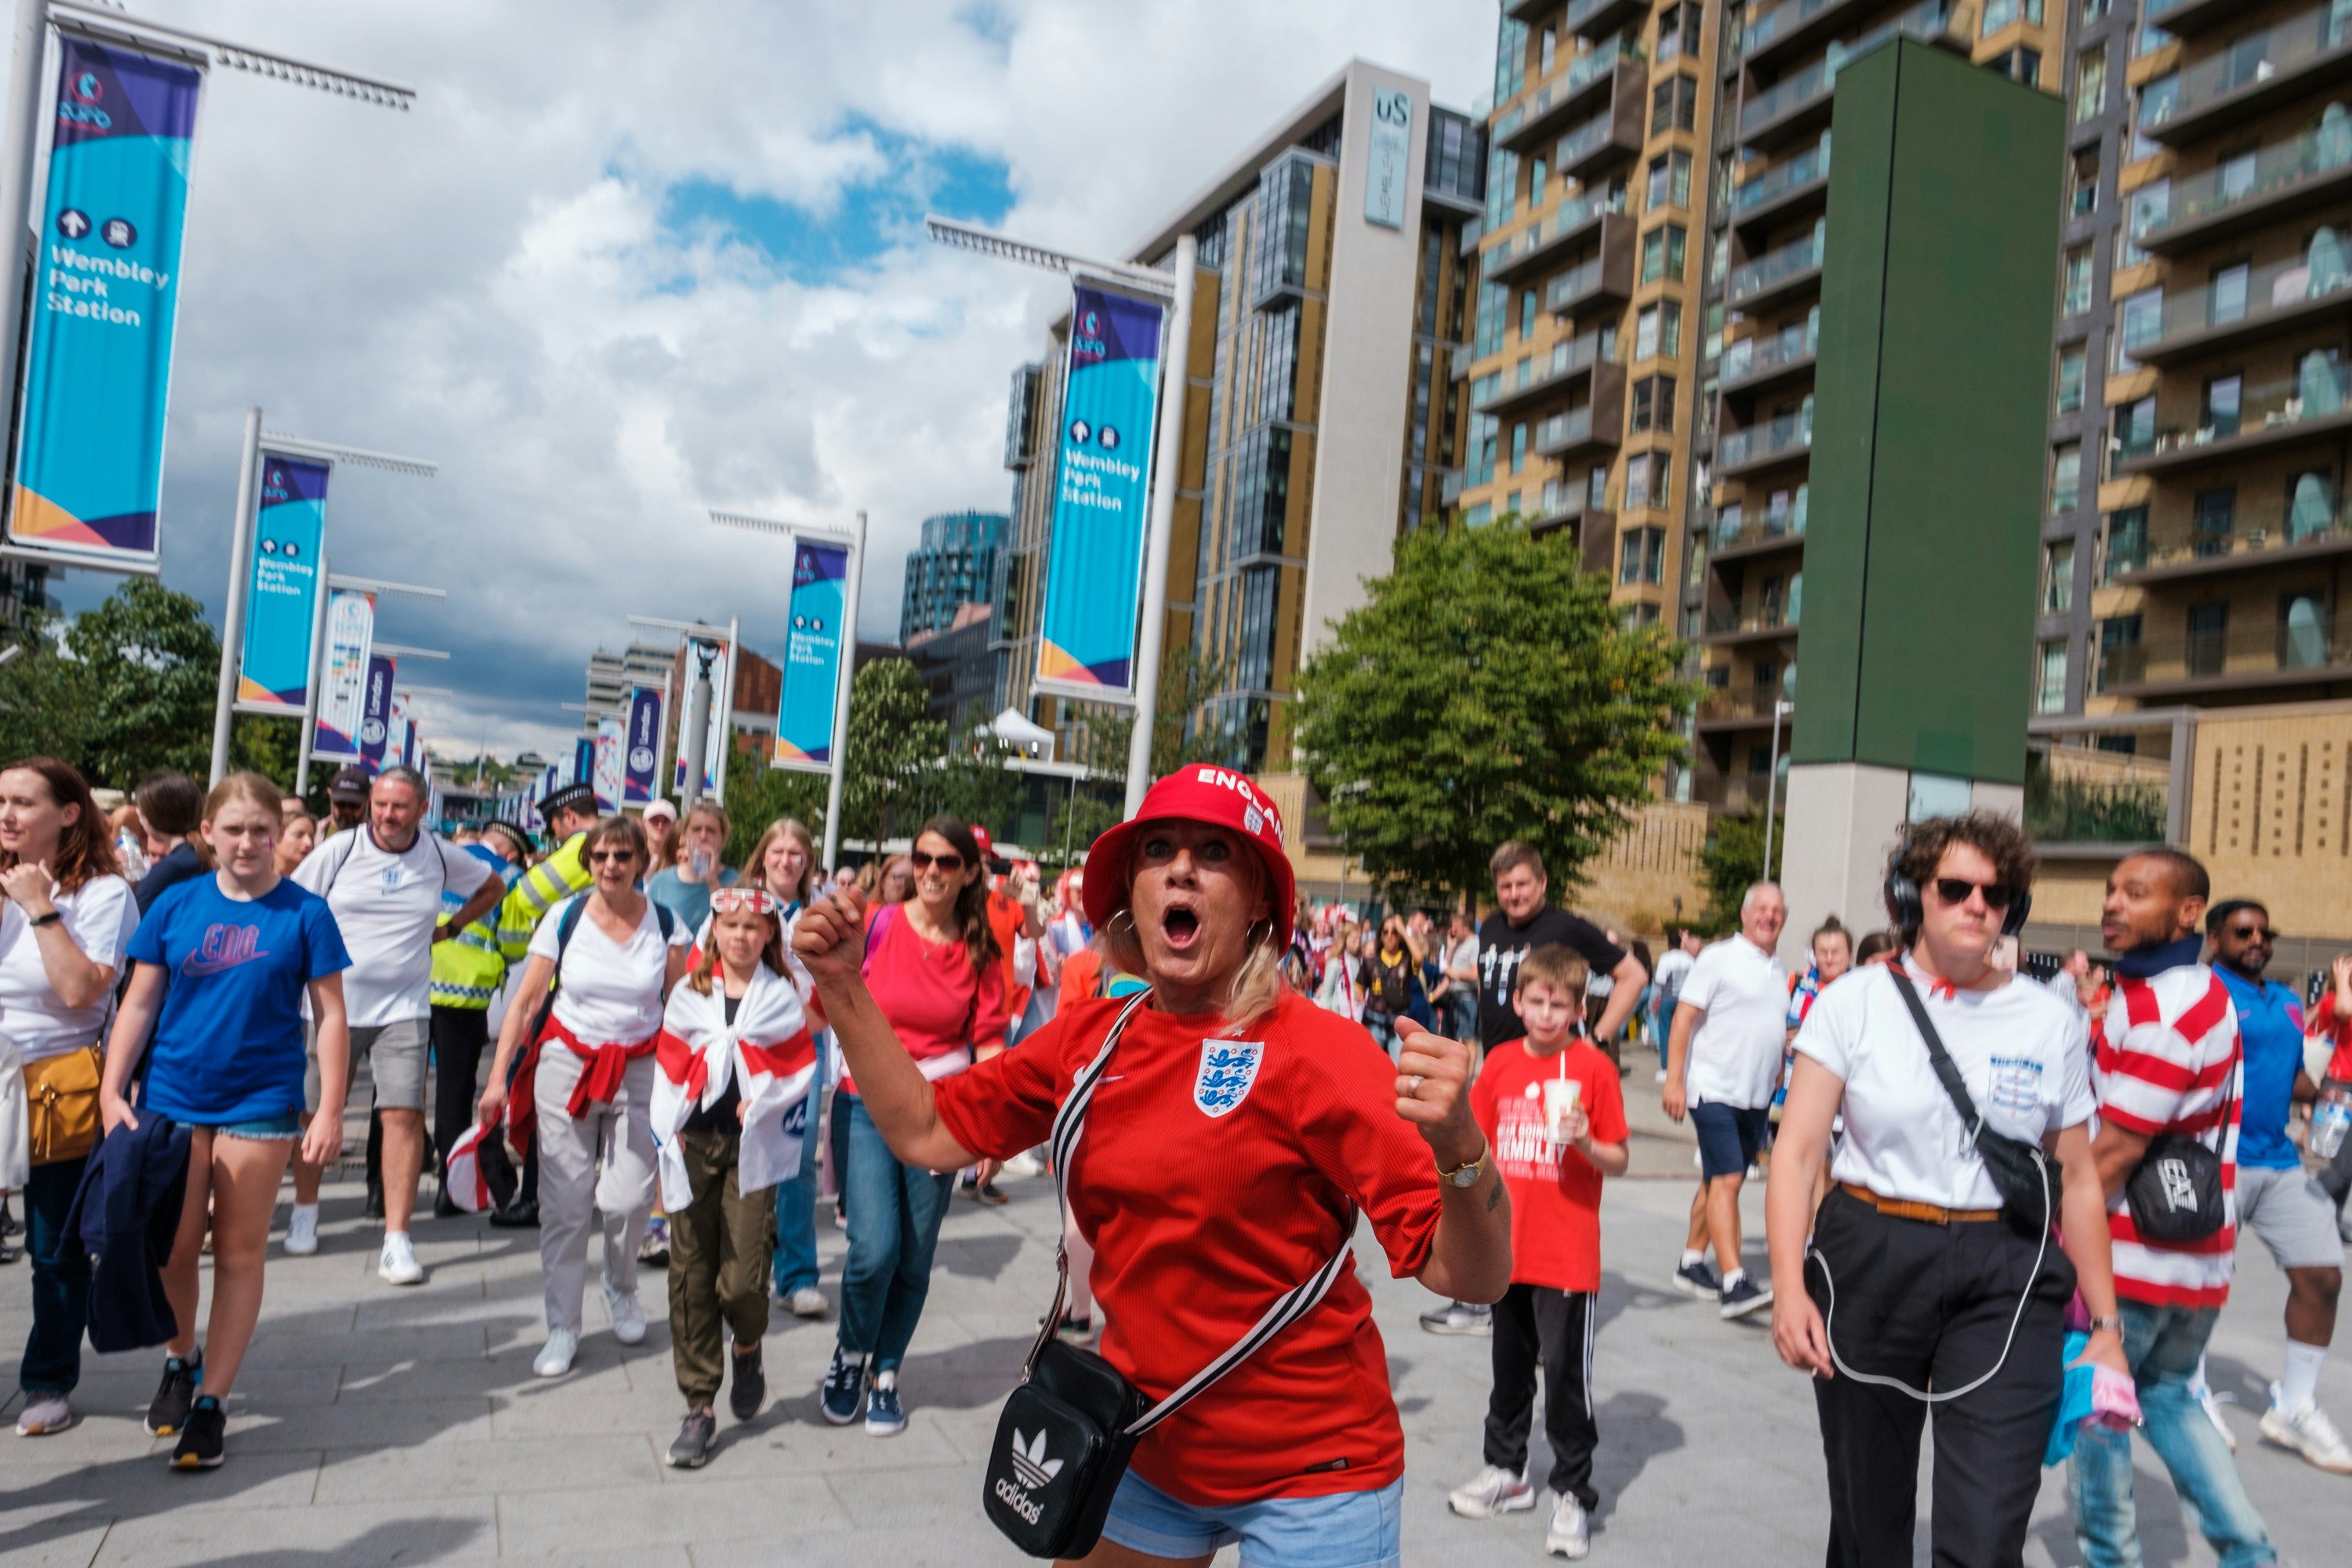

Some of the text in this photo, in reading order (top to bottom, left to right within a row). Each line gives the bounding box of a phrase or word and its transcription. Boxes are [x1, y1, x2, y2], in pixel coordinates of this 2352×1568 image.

[51, 244, 169, 290] Wembley
[49, 267, 108, 299] Park
[47, 292, 141, 328] Station
[1064, 465, 1101, 489] Park
[1065, 447, 1140, 483] Wembley
[1062, 485, 1122, 513] Station
[257, 568, 285, 583] Park
[259, 557, 314, 578] Wembley
[256, 580, 301, 596] Station
[791, 631, 835, 648] Wembley
[789, 654, 824, 666] Station
[368, 671, 383, 716] London
[1198, 768, 1285, 853] ENGLAN
[996, 1478, 1040, 1526] adidas
